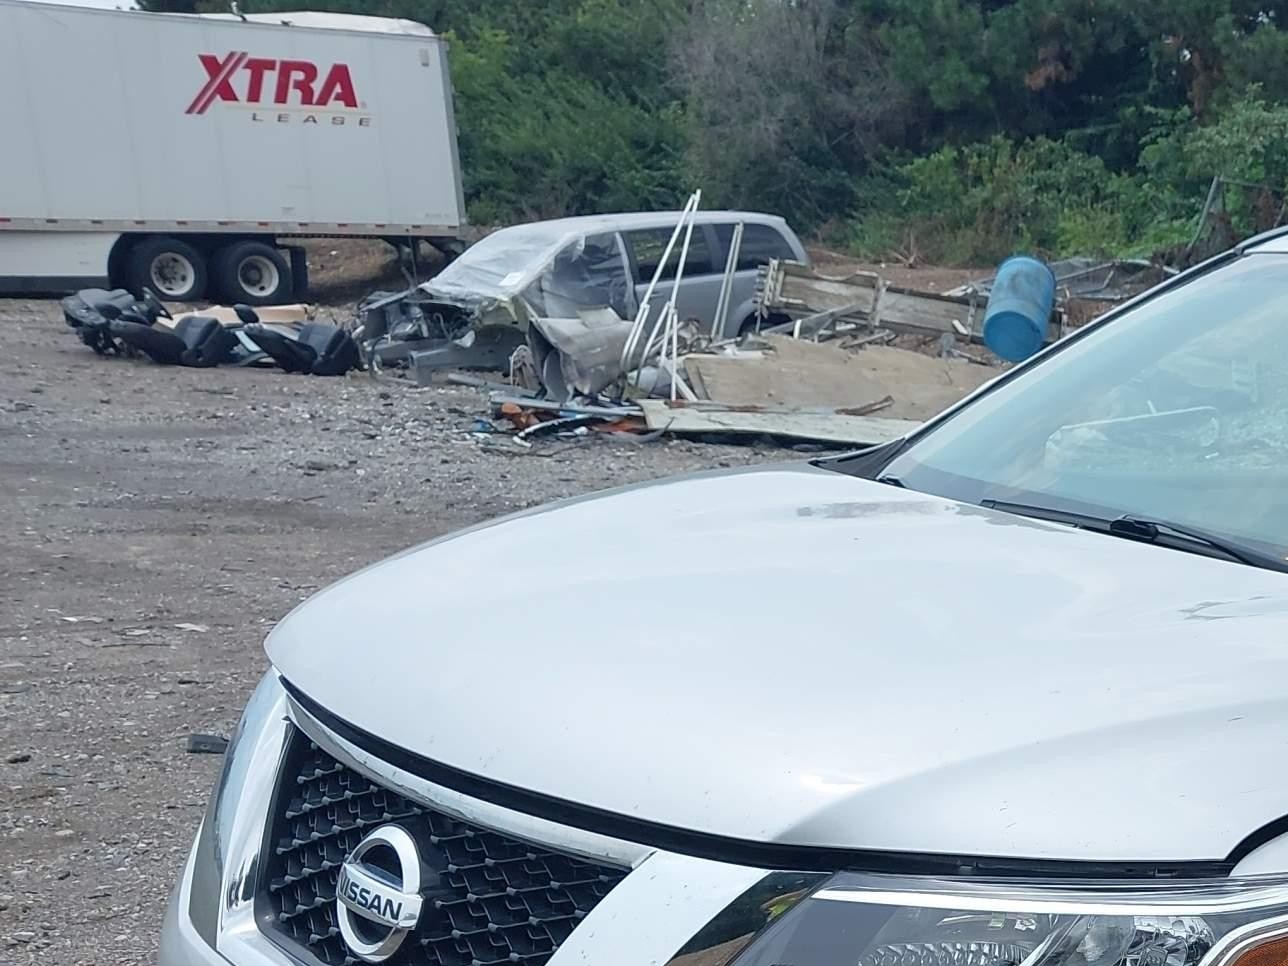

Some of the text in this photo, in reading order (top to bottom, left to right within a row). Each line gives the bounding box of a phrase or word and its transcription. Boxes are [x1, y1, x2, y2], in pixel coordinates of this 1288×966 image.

[185, 51, 358, 114] XTRA
[252, 112, 372, 127] LEASE
[338, 876, 403, 921] NISSAN
